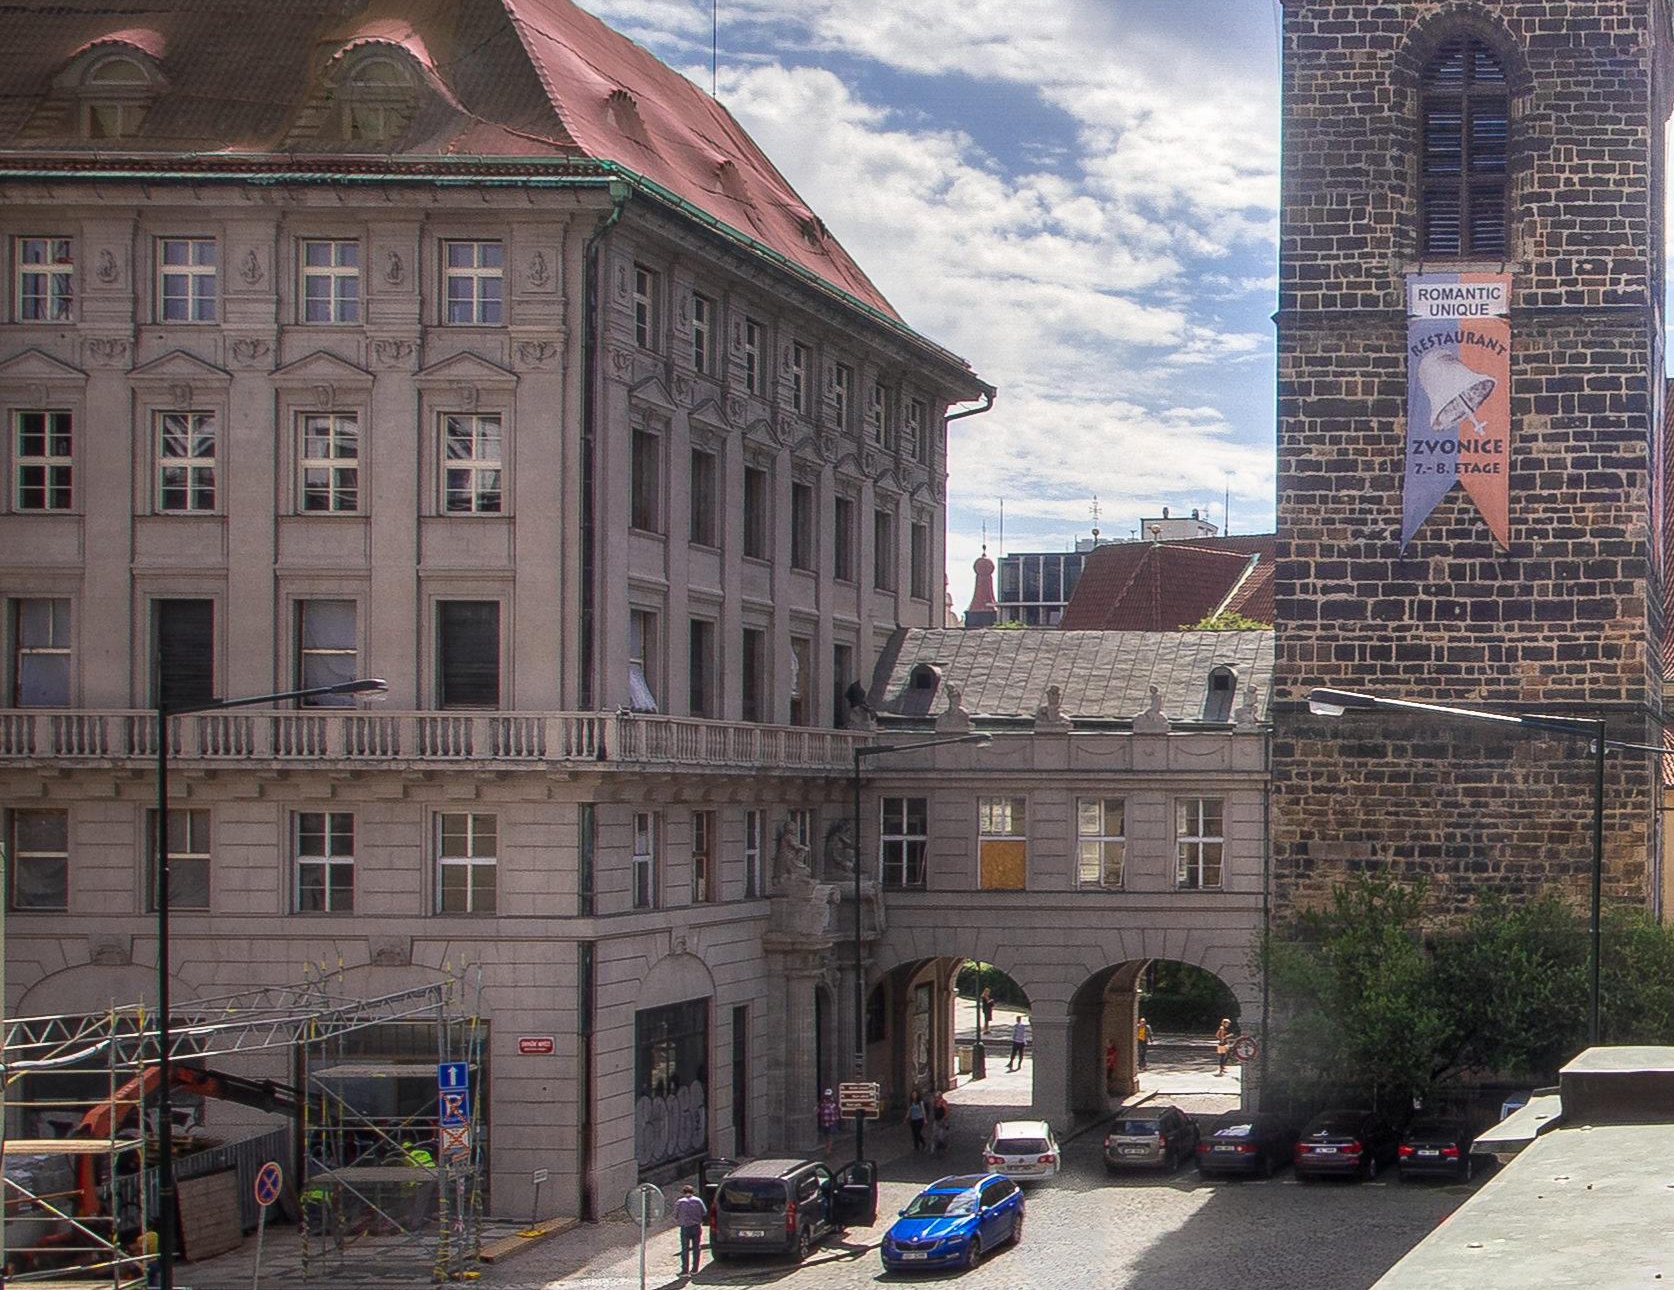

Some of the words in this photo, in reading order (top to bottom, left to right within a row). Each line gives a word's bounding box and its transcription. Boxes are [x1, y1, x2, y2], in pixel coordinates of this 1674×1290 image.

[1418, 287, 1501, 301] ROMANTIC
[1429, 303, 1490, 316] UNIQUE
[1410, 331, 1507, 357] RESTAURANT
[1412, 439, 1503, 455] ZVONICE
[1455, 462, 1501, 474] ETAGE
